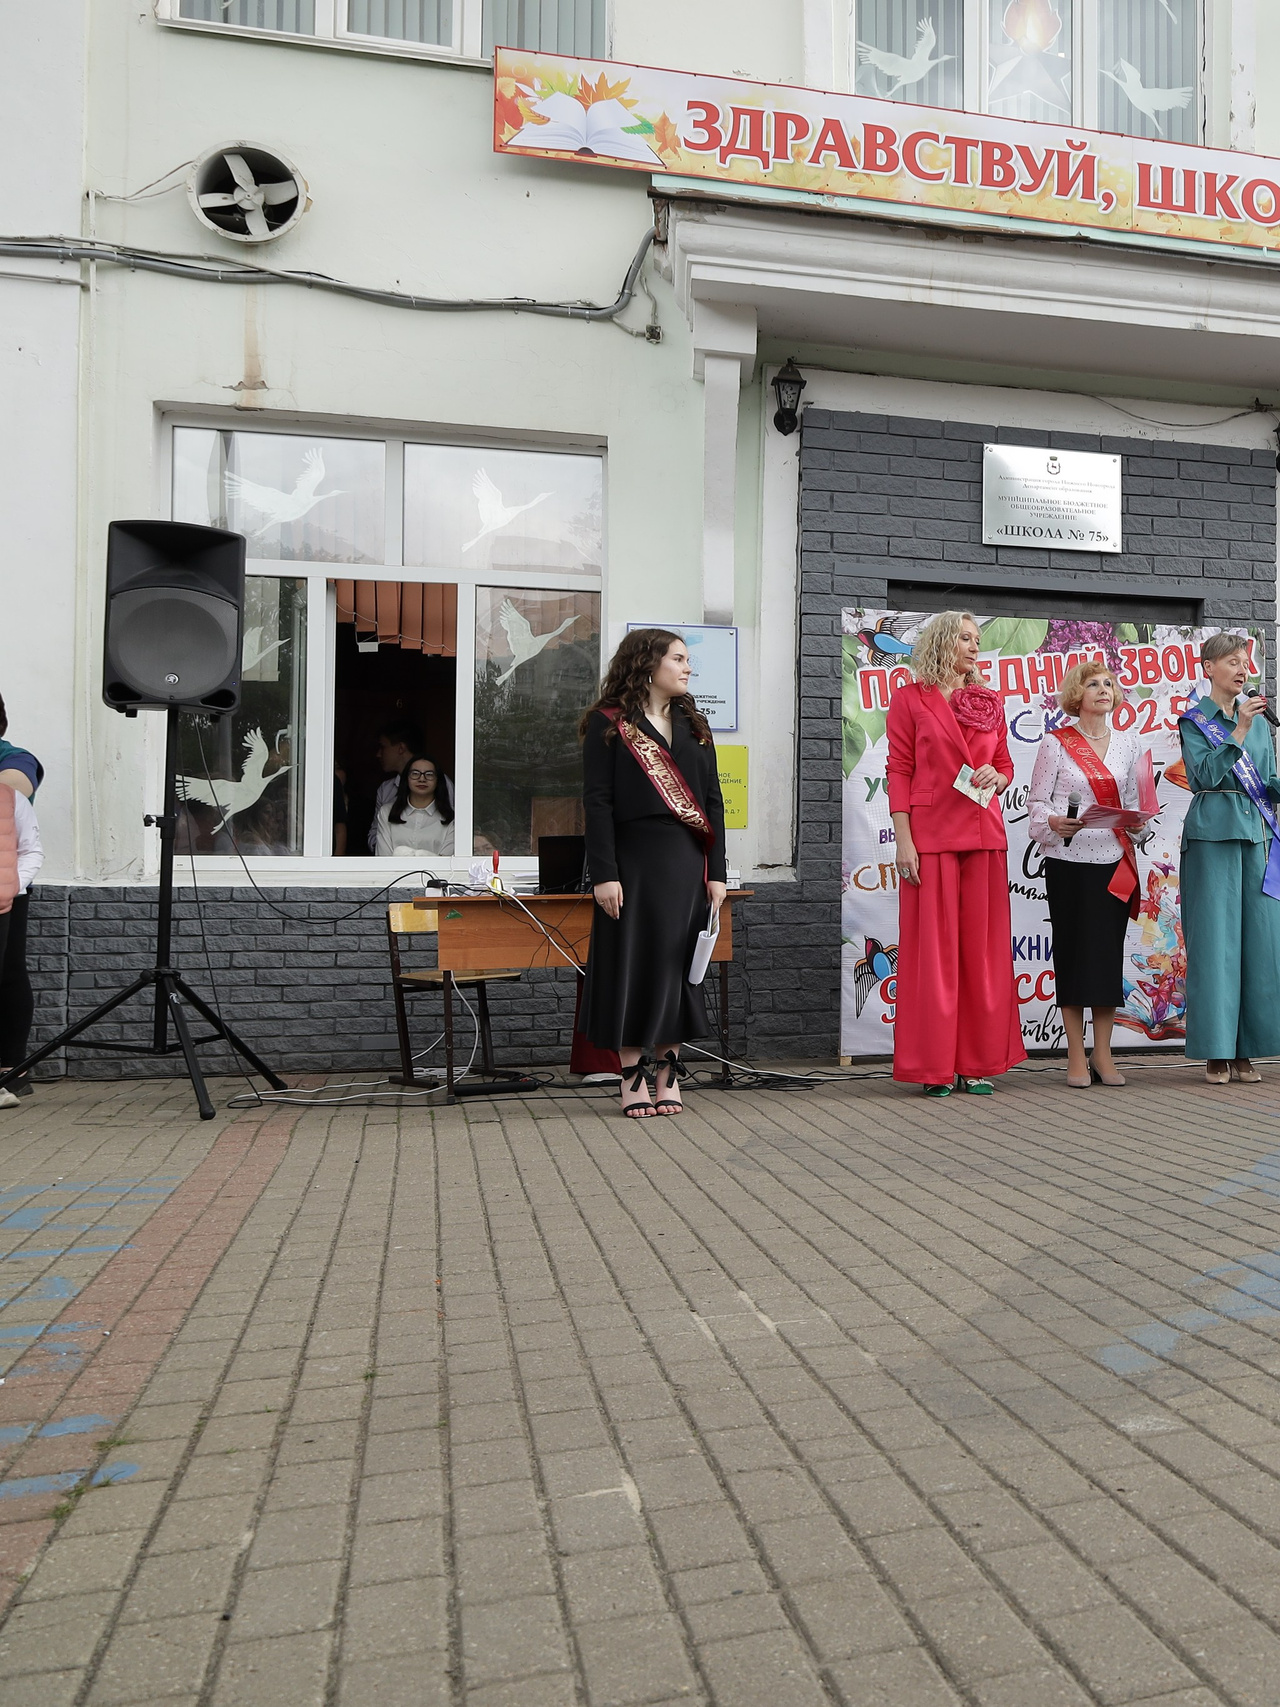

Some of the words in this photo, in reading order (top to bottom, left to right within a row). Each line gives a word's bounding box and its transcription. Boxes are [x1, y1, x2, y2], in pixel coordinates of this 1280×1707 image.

[682, 99, 1117, 212] ЗДРАВСТВУЙ,
[997, 495, 1062, 505] МУНИЦИПАЛЬНОЕ
[1063, 501, 1108, 509] БЮДЖЕТНОЕ
[1010, 503, 1096, 515] ОБЩЕОБРАЗОВАТЕЛЬНОЕ
[1029, 512, 1077, 521] УЧРЕЖДЕНИЕ
[996, 524, 1064, 540] «ШКОЛА
[1088, 530, 1109, 542] 75»
[859, 646, 1104, 709] ПОДНИ
[1119, 638, 1258, 687] ЗВОН
[1112, 695, 1190, 735] 025
